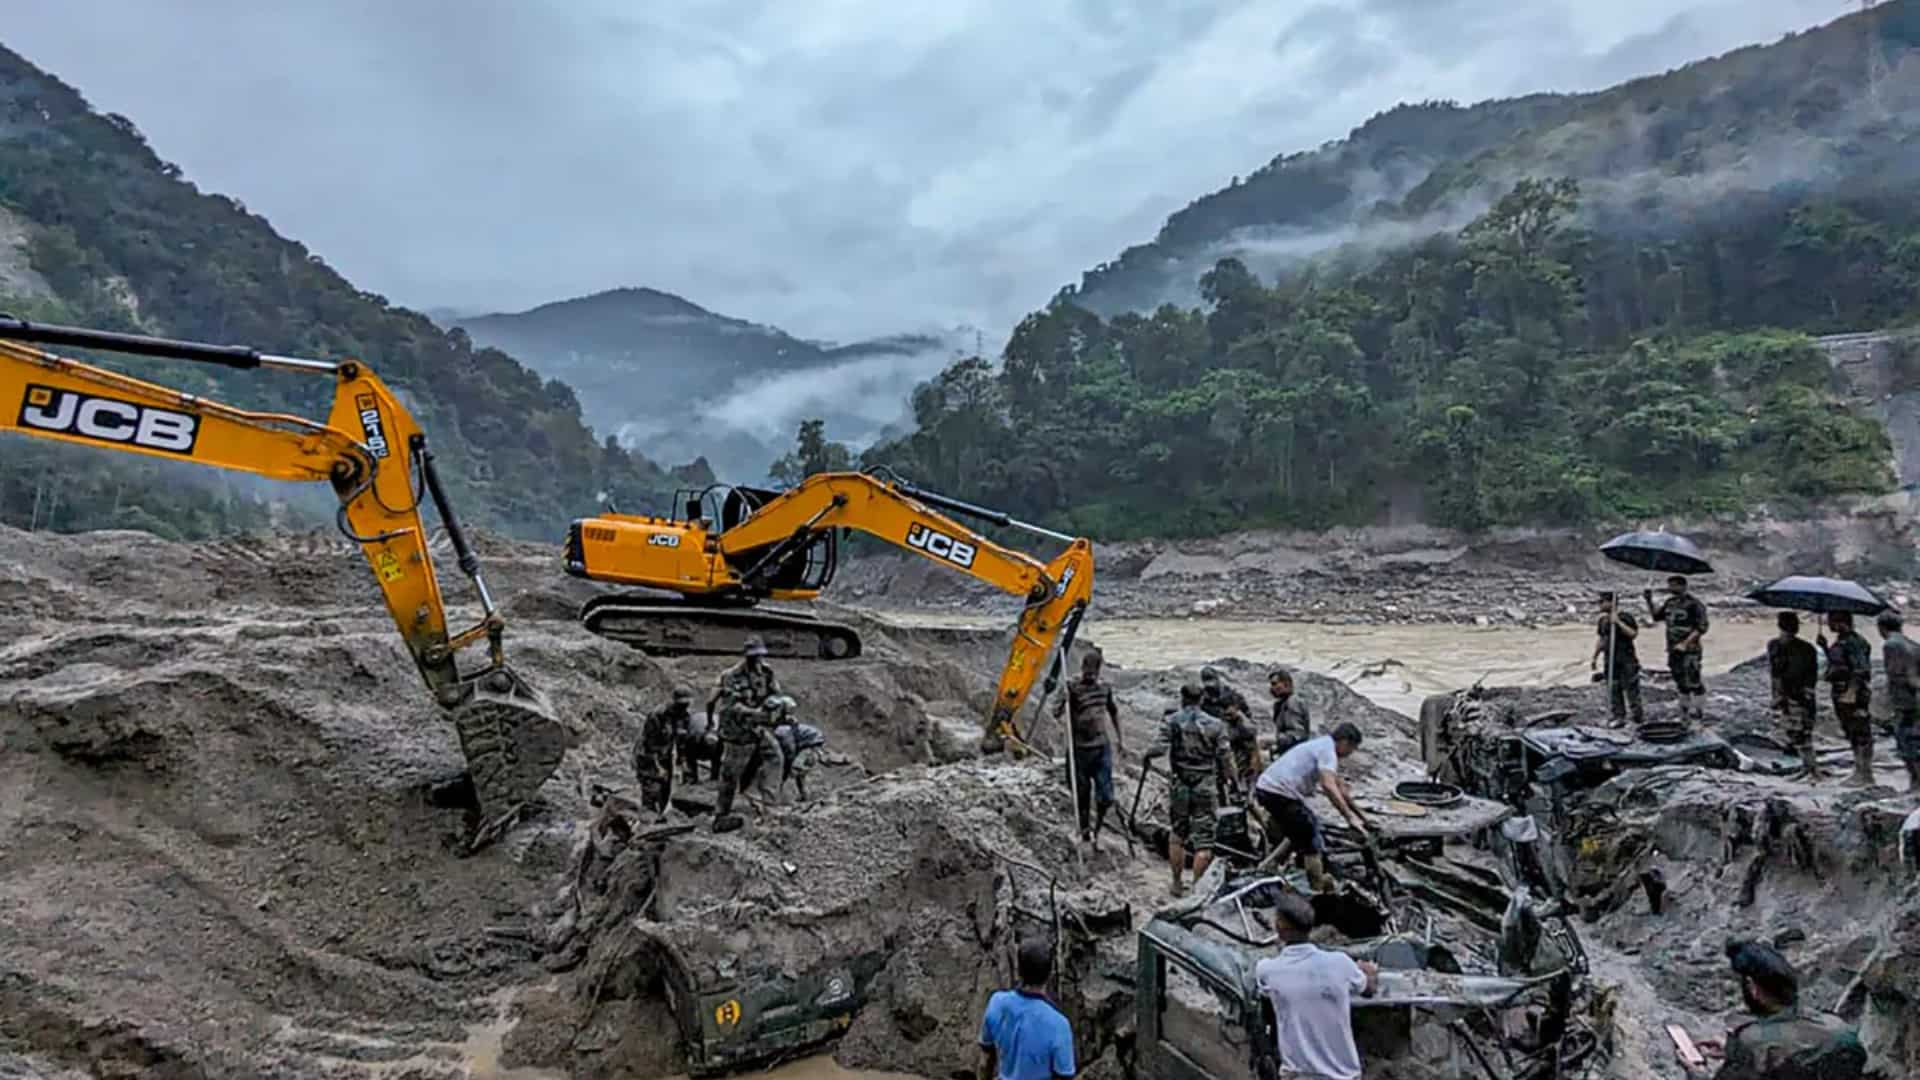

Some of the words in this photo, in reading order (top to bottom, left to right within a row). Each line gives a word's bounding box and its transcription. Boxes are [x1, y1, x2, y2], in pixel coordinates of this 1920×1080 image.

[24, 393, 195, 450] JCB
[647, 535, 679, 546] JCB
[908, 528, 975, 566] JCB
